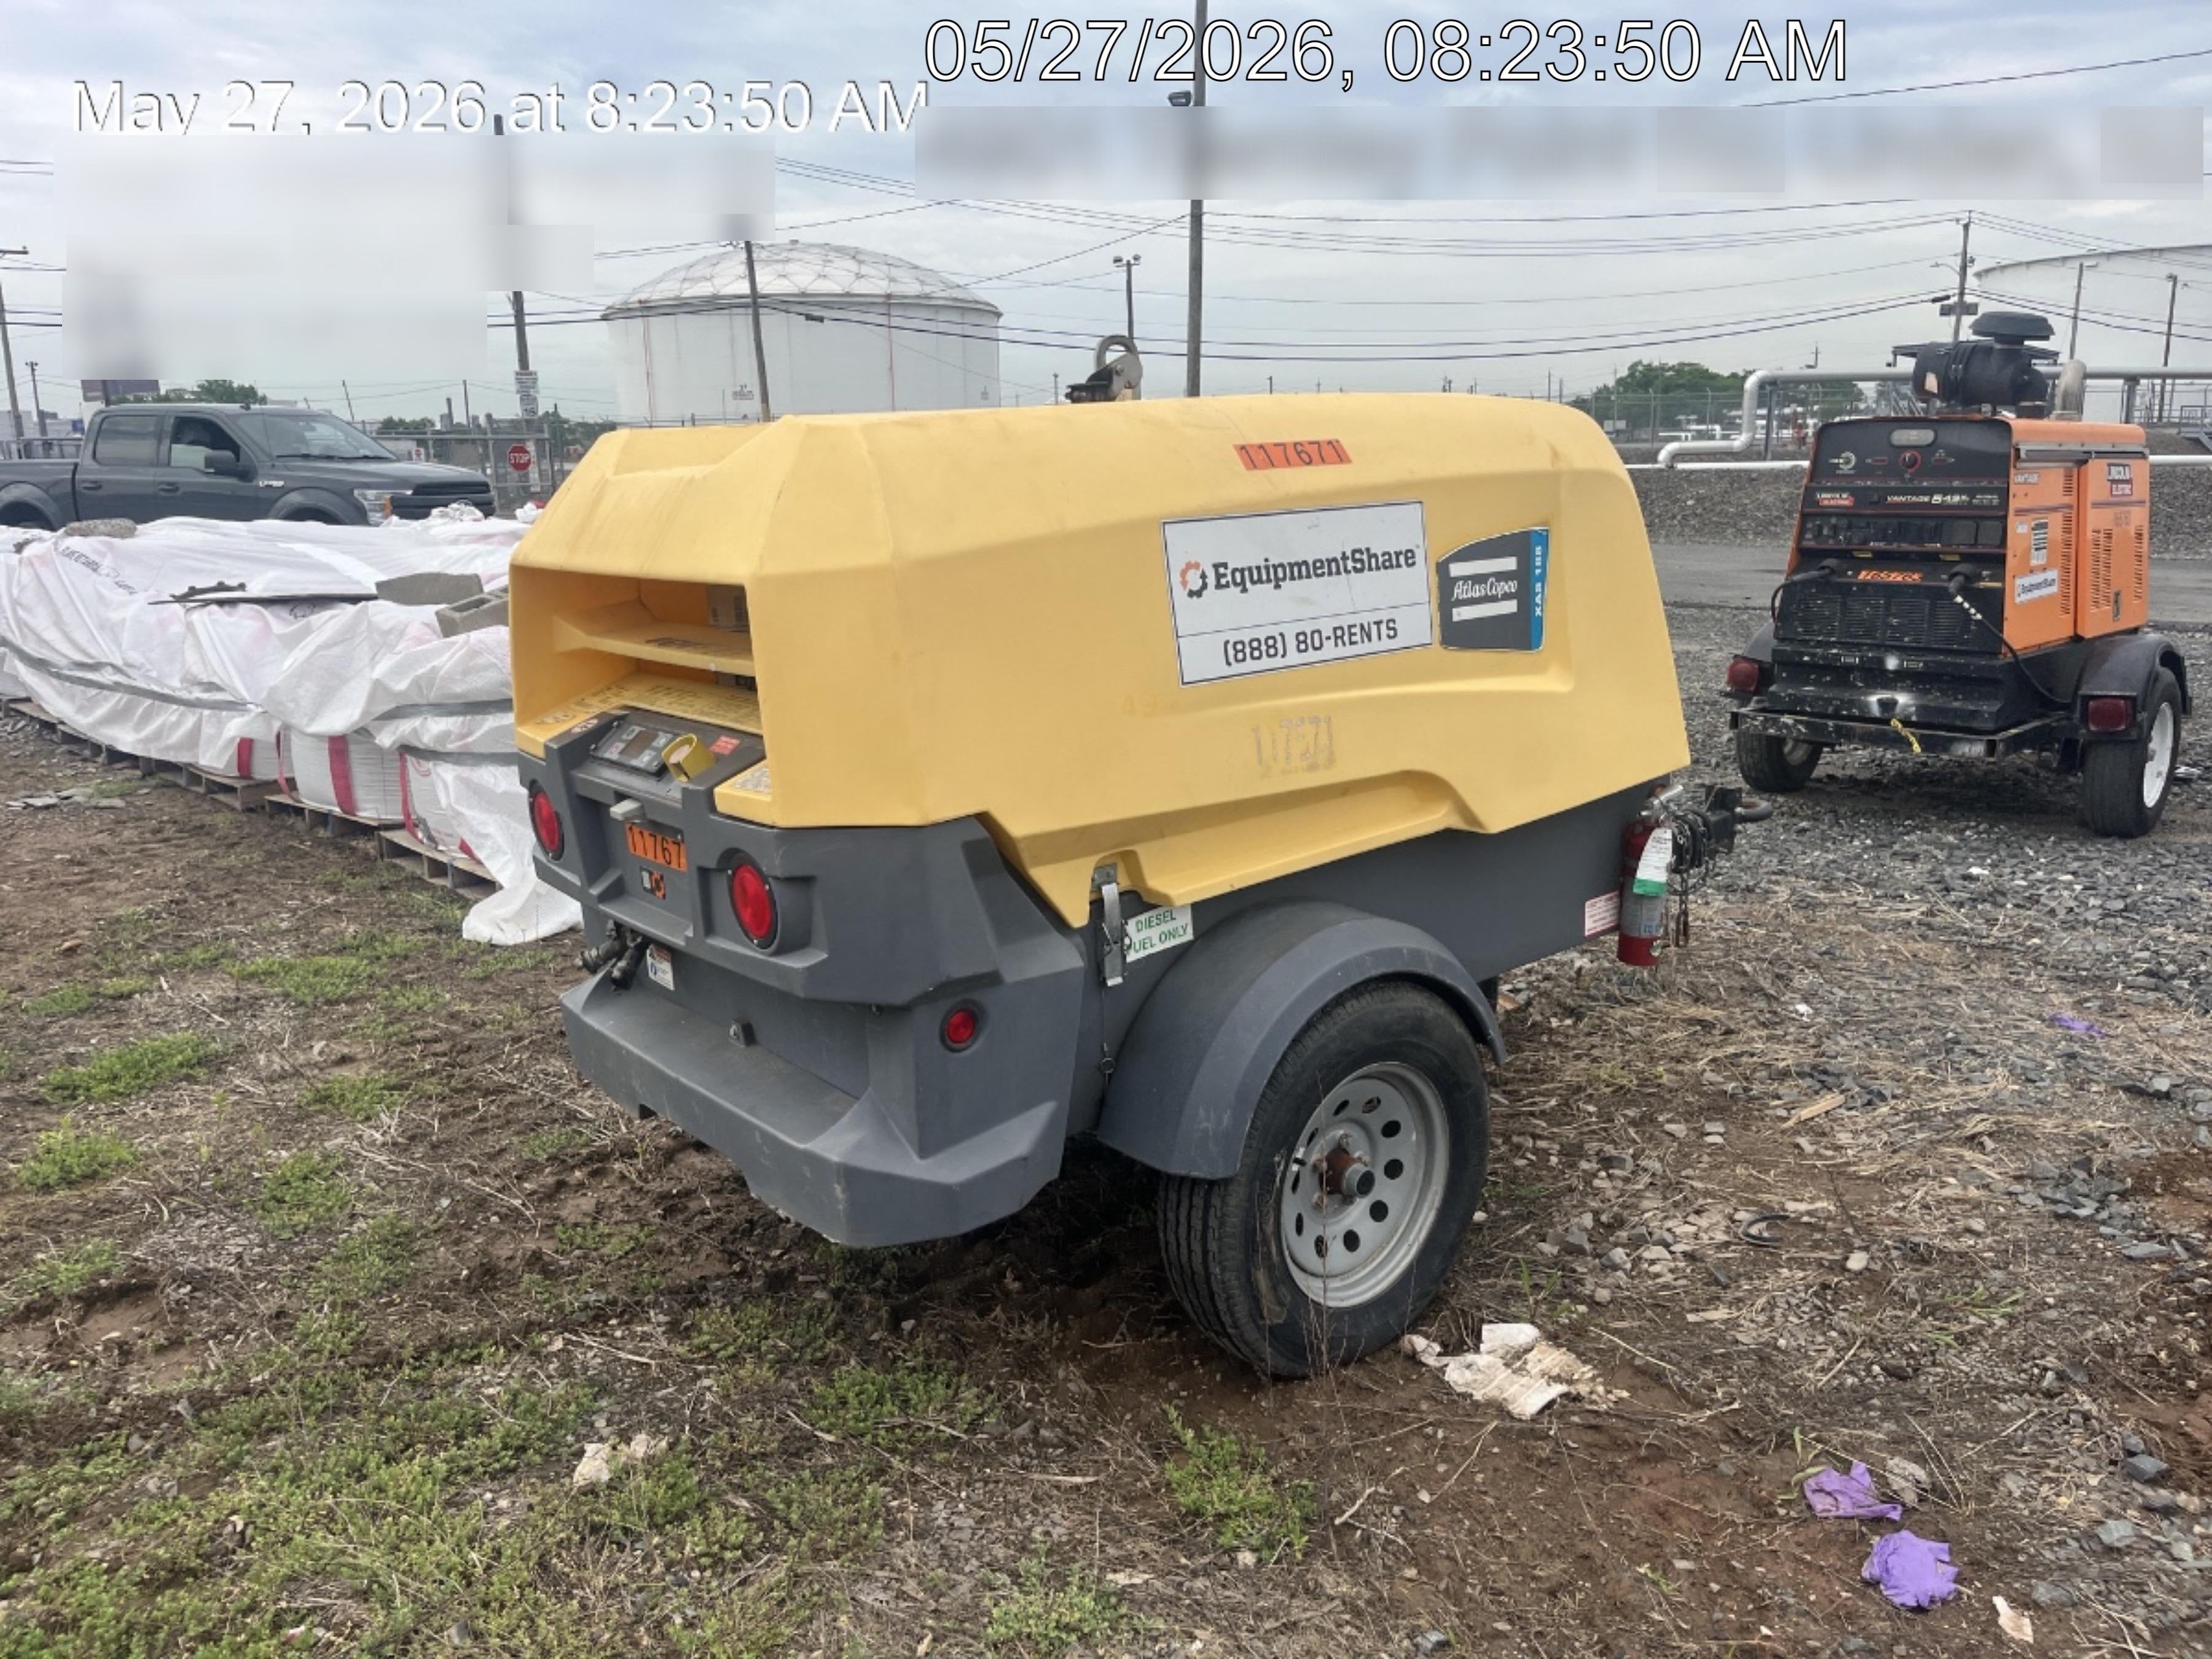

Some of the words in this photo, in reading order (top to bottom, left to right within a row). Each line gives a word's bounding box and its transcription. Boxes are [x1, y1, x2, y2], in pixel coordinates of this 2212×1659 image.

[509, 453, 530, 463] STOP
[1240, 440, 1344, 469] 117671
[1212, 547, 1416, 594] EquipmentShare
[1223, 631, 1287, 666] (888)
[1295, 619, 1398, 654] 80-RENTS
[1136, 909, 1177, 933] DIESEL
[1129, 937, 1156, 953] UEL
[1159, 923, 1188, 944] ONLY
